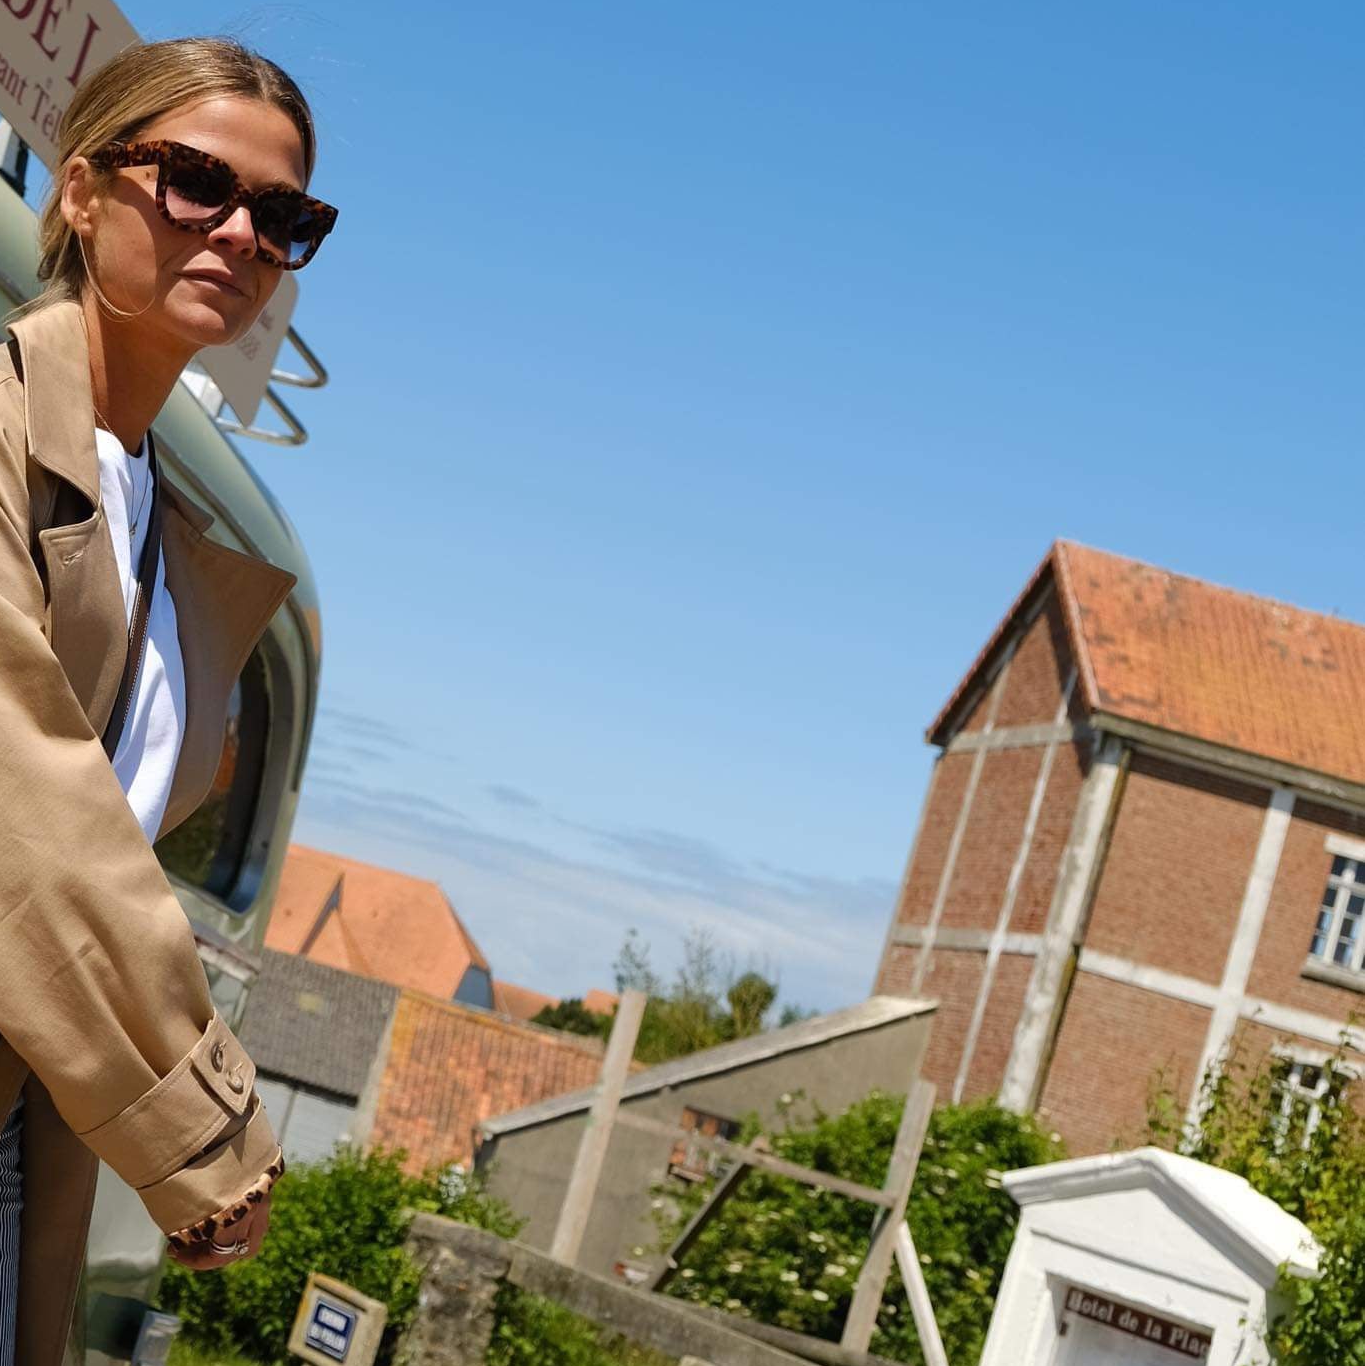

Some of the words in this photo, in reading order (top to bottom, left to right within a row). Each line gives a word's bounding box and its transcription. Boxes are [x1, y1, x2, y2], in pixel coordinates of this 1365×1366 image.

[1068, 1290, 1115, 1322] Hotel
[1118, 1310, 1140, 1331] de
[1143, 1318, 1163, 1340] la
